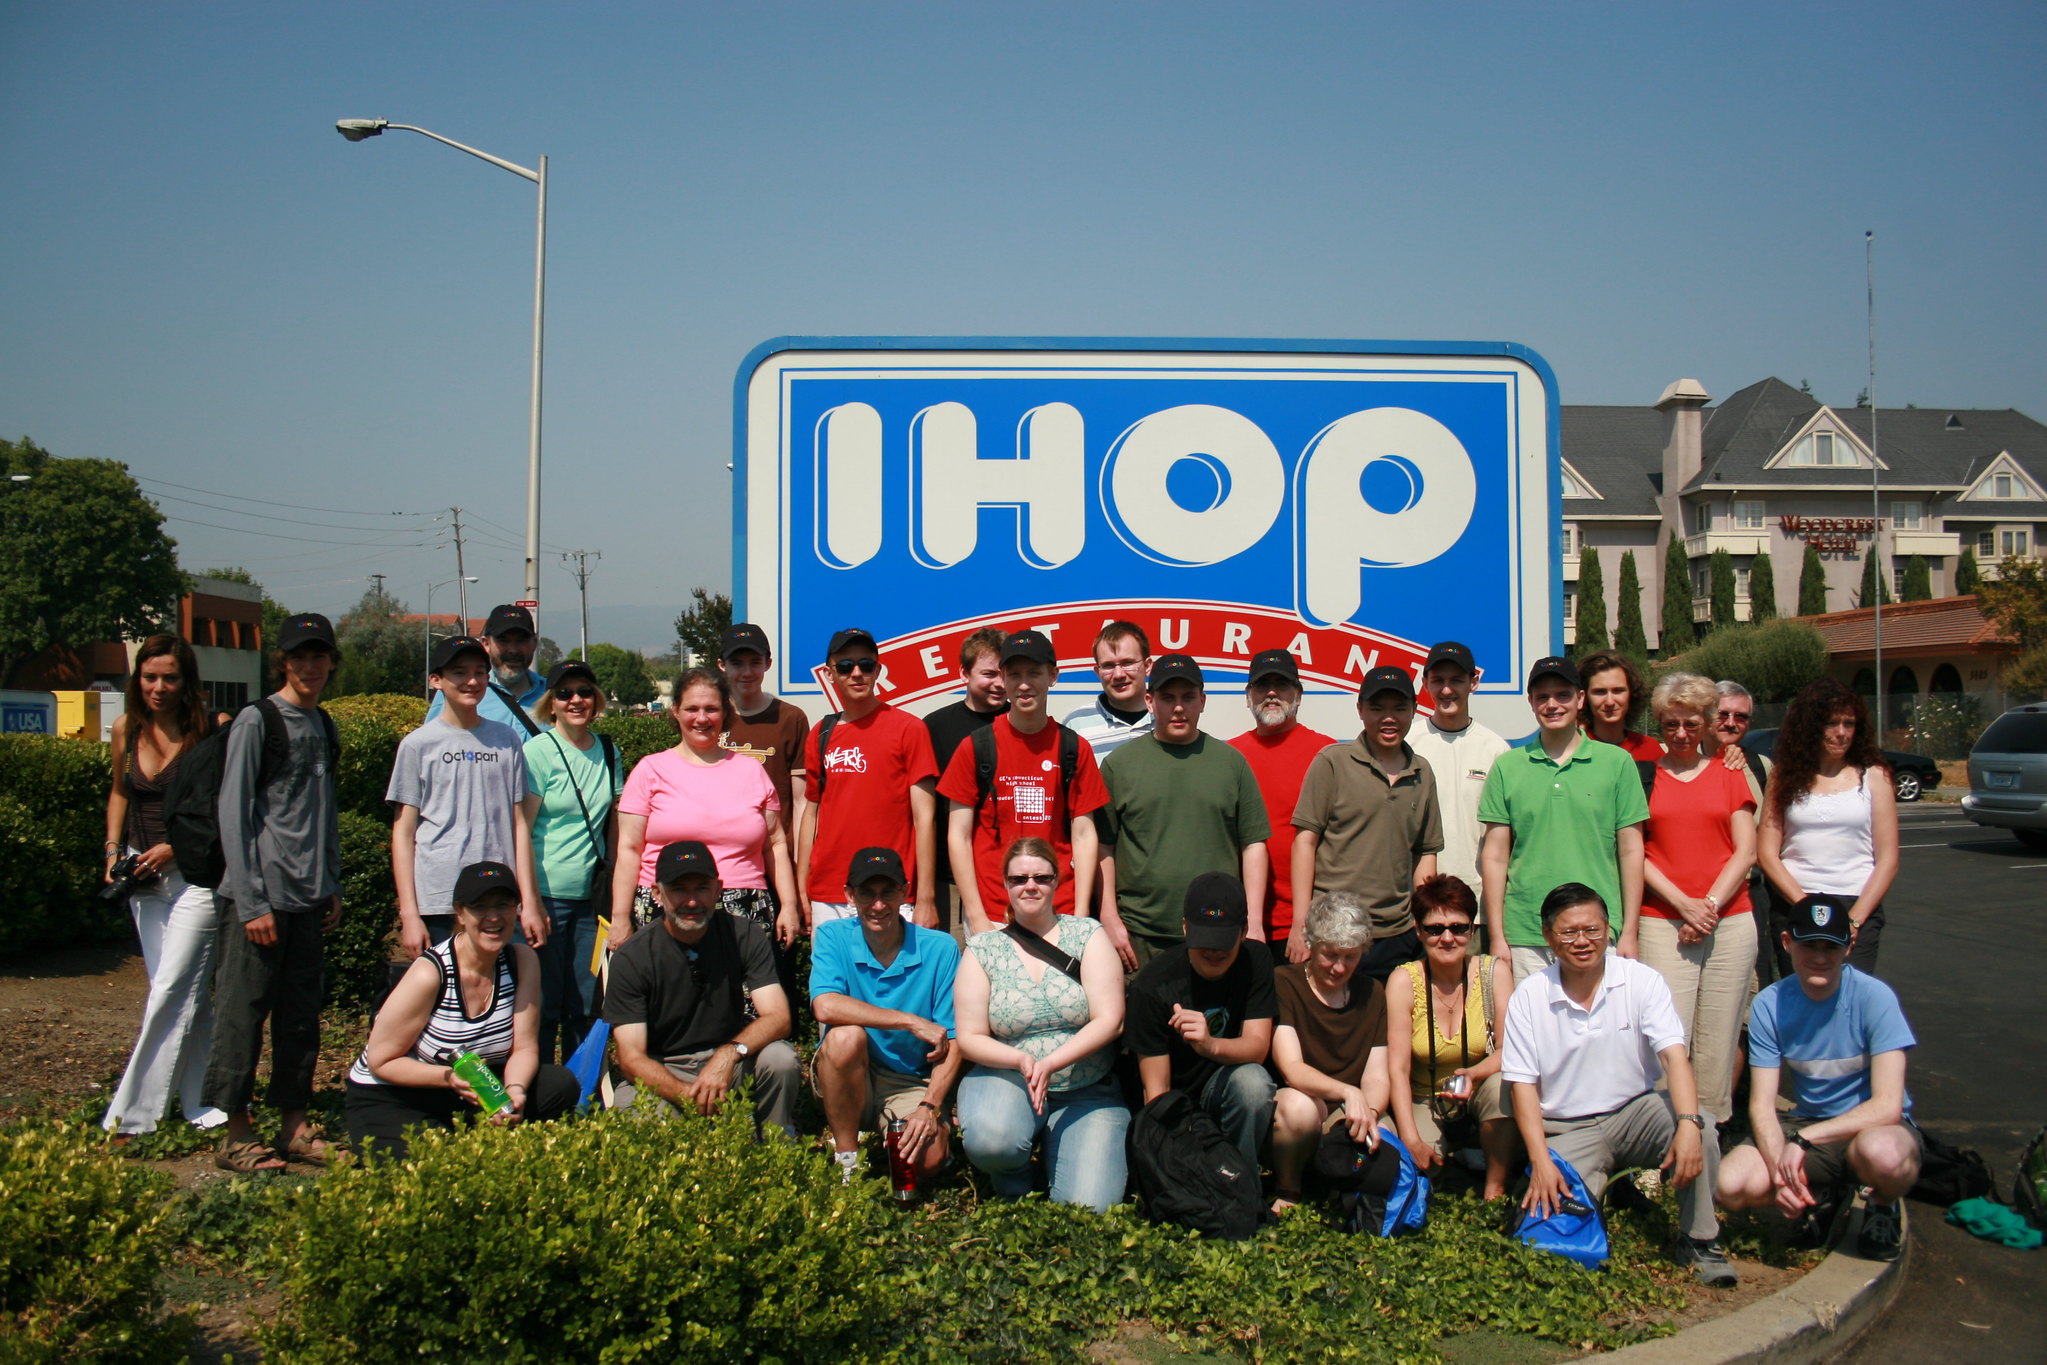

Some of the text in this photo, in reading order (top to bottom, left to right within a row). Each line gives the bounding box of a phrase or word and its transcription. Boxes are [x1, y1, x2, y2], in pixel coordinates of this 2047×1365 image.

[873, 618, 1425, 696] RETURANT
[18, 712, 43, 730] USA
[442, 749, 499, 764] Octopart
